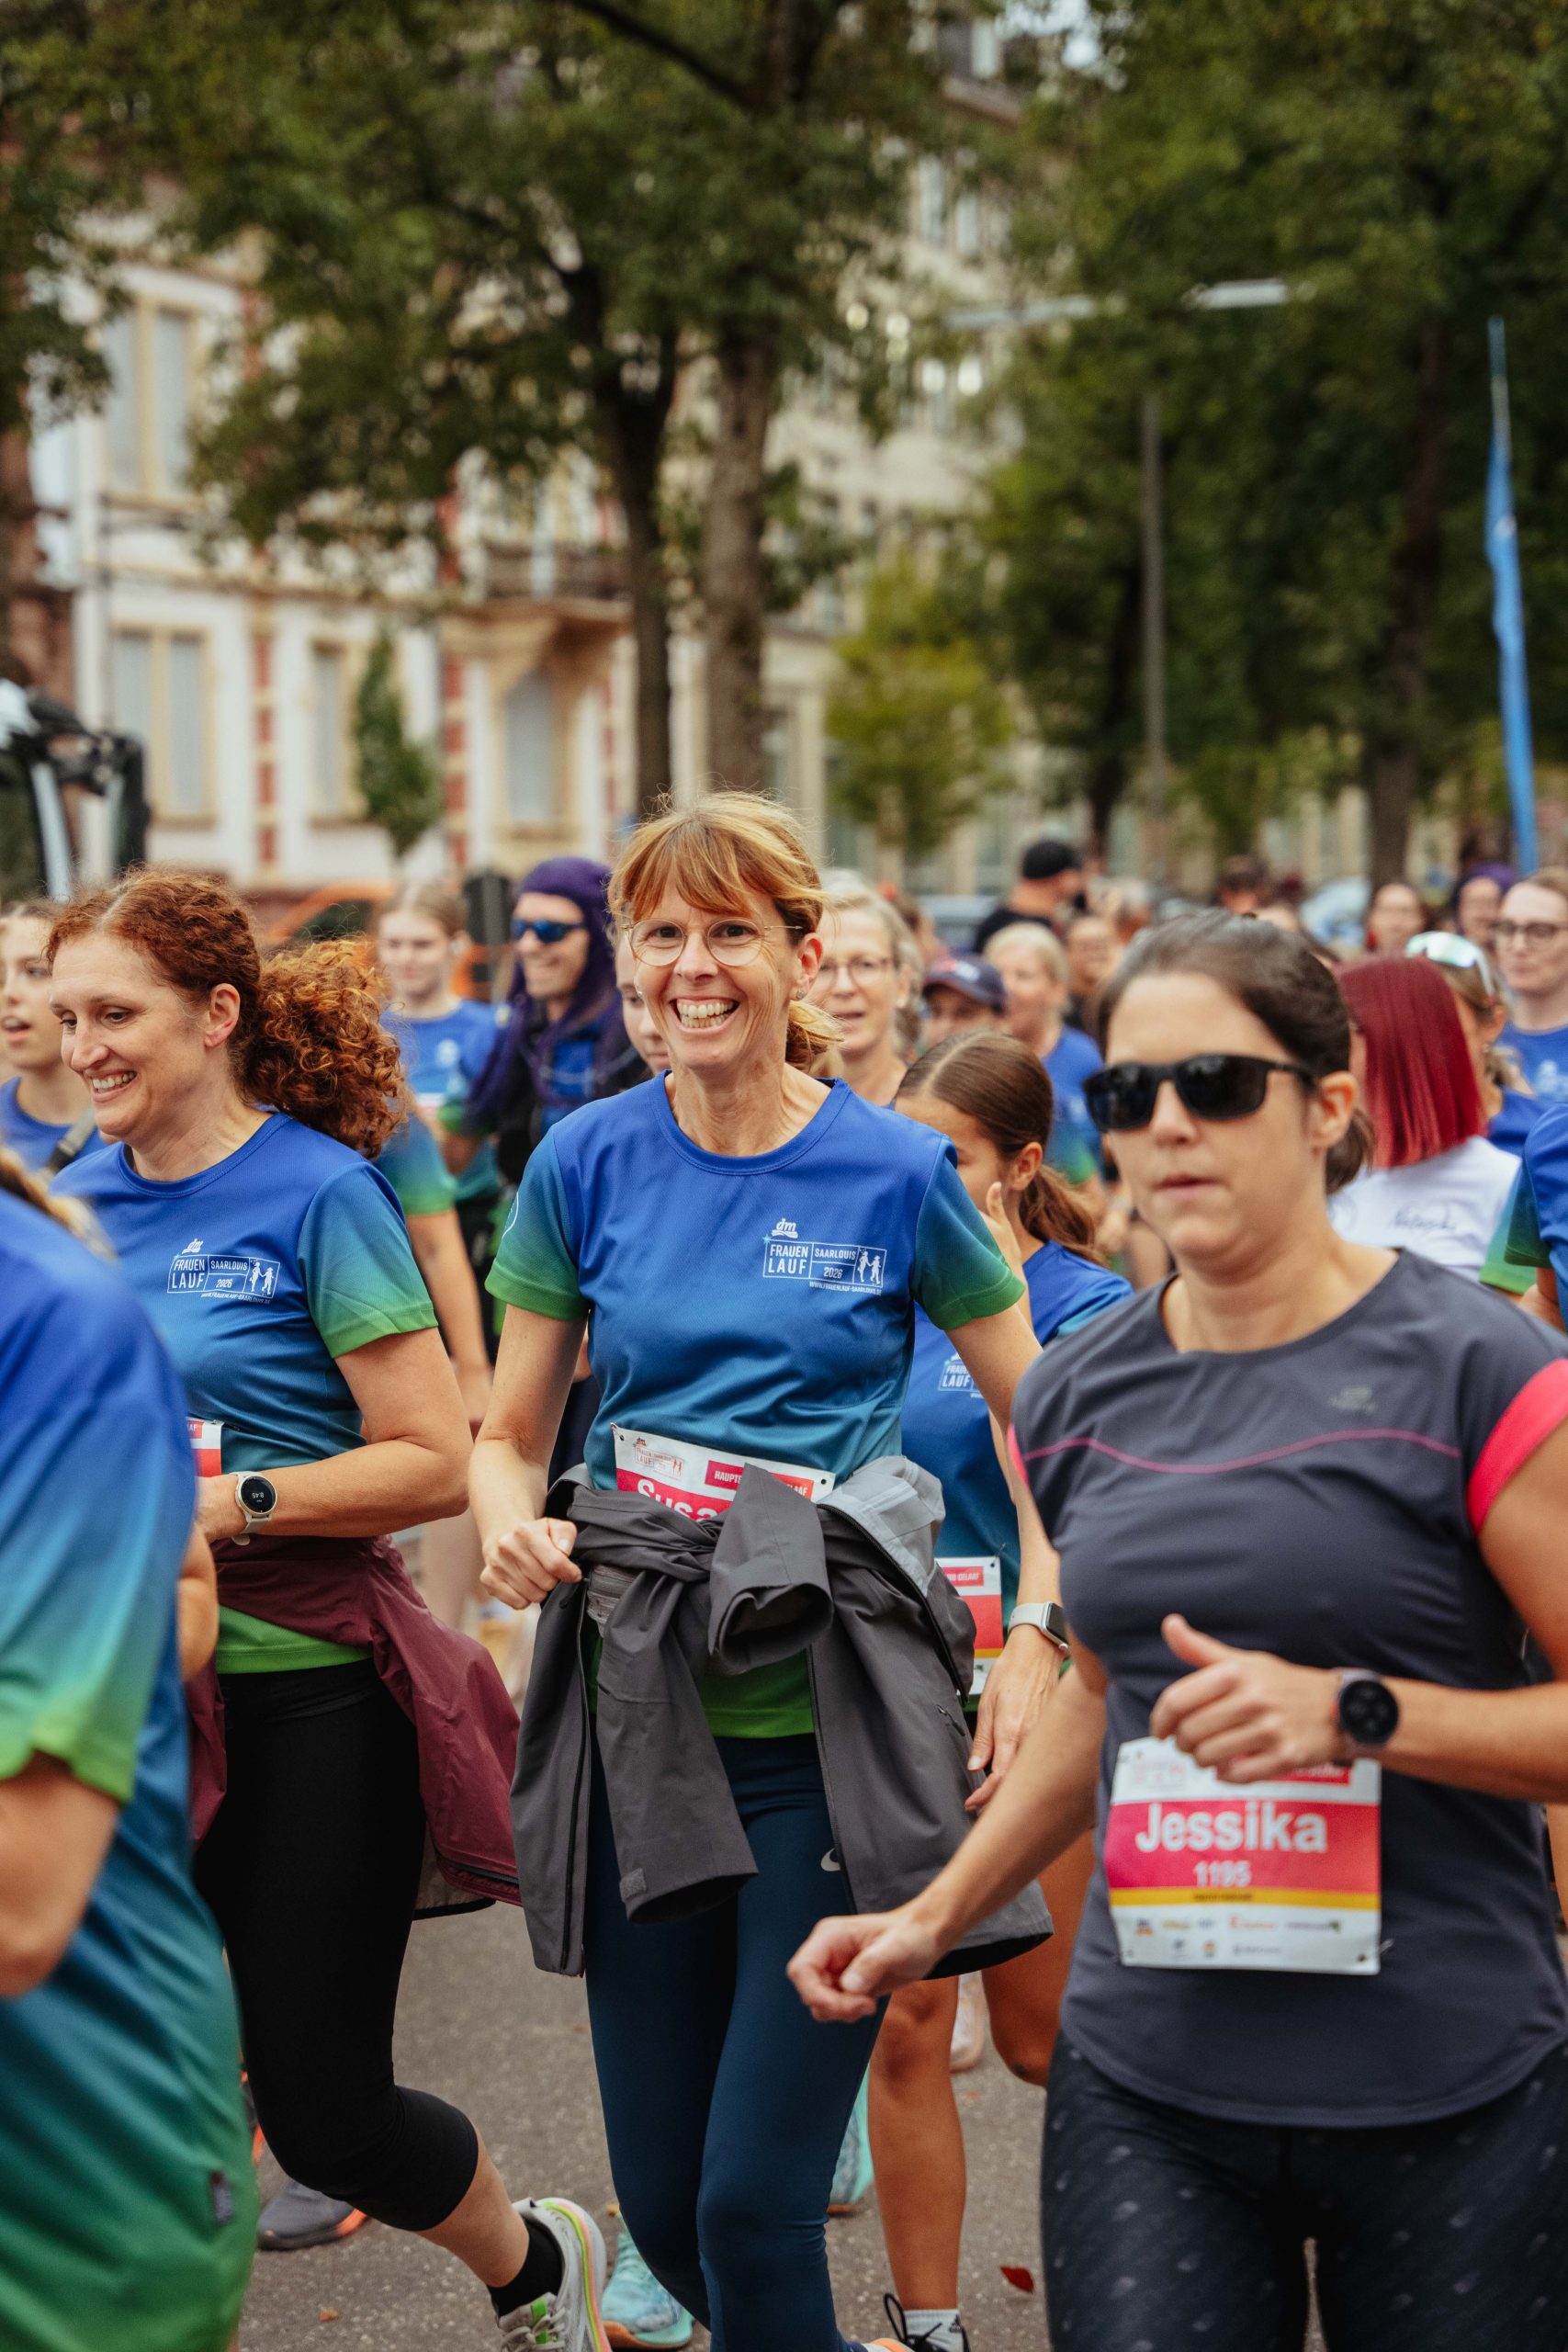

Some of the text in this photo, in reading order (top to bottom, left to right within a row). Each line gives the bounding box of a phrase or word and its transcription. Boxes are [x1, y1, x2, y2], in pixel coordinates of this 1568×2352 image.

[776, 1217, 796, 1231] dm
[770, 1244, 808, 1258] FRAUEN
[815, 1249, 856, 1260] SAARLOUIS
[174, 1259, 205, 1272] FRAUEN
[211, 1261, 247, 1271] SAARLOUIS
[769, 1259, 807, 1274] LAUF
[824, 1267, 842, 1279] 2026
[172, 1272, 204, 1288] LAUF
[216, 1279, 232, 1288] 2026
[942, 1374, 970, 1387] LAUF
[1135, 1802, 1326, 1853] Jessika
[1194, 1860, 1251, 1887] 1195
